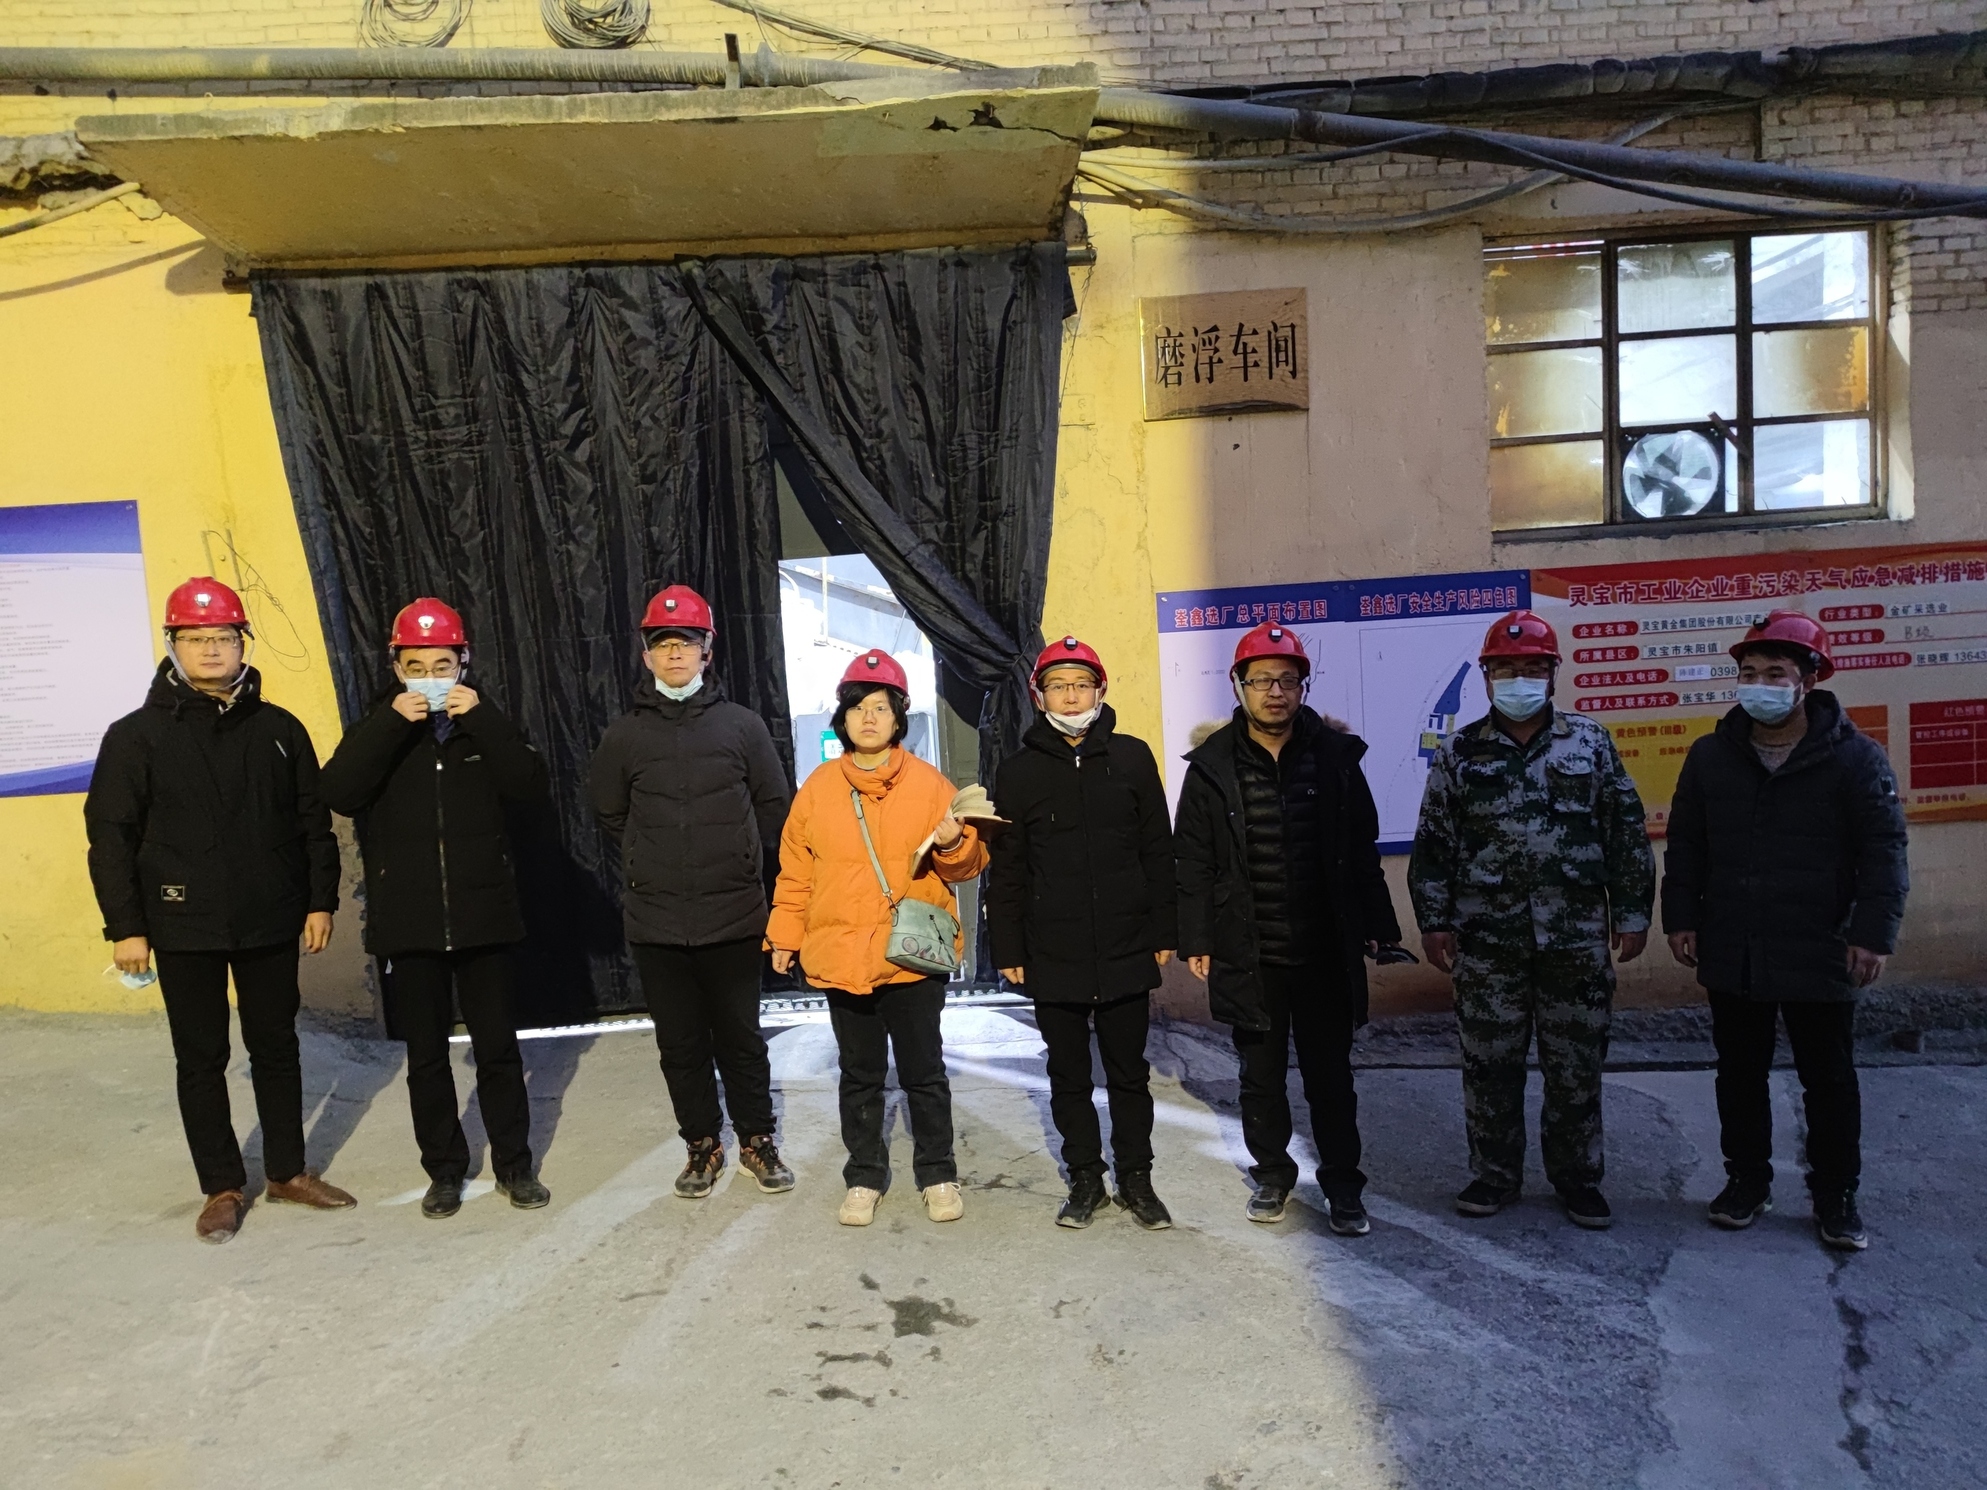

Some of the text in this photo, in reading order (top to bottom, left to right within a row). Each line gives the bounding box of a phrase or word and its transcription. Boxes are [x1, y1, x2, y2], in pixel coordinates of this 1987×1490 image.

[1155, 320, 1297, 388] 磨浮车间
[1890, 602, 1948, 616] 金矿采选业
[1647, 642, 1718, 658] 灵宝市朱阳镇
[1955, 650, 1987, 662] 13643
[1710, 666, 1737, 677] 0398
[1682, 691, 1716, 703] 张宝华
